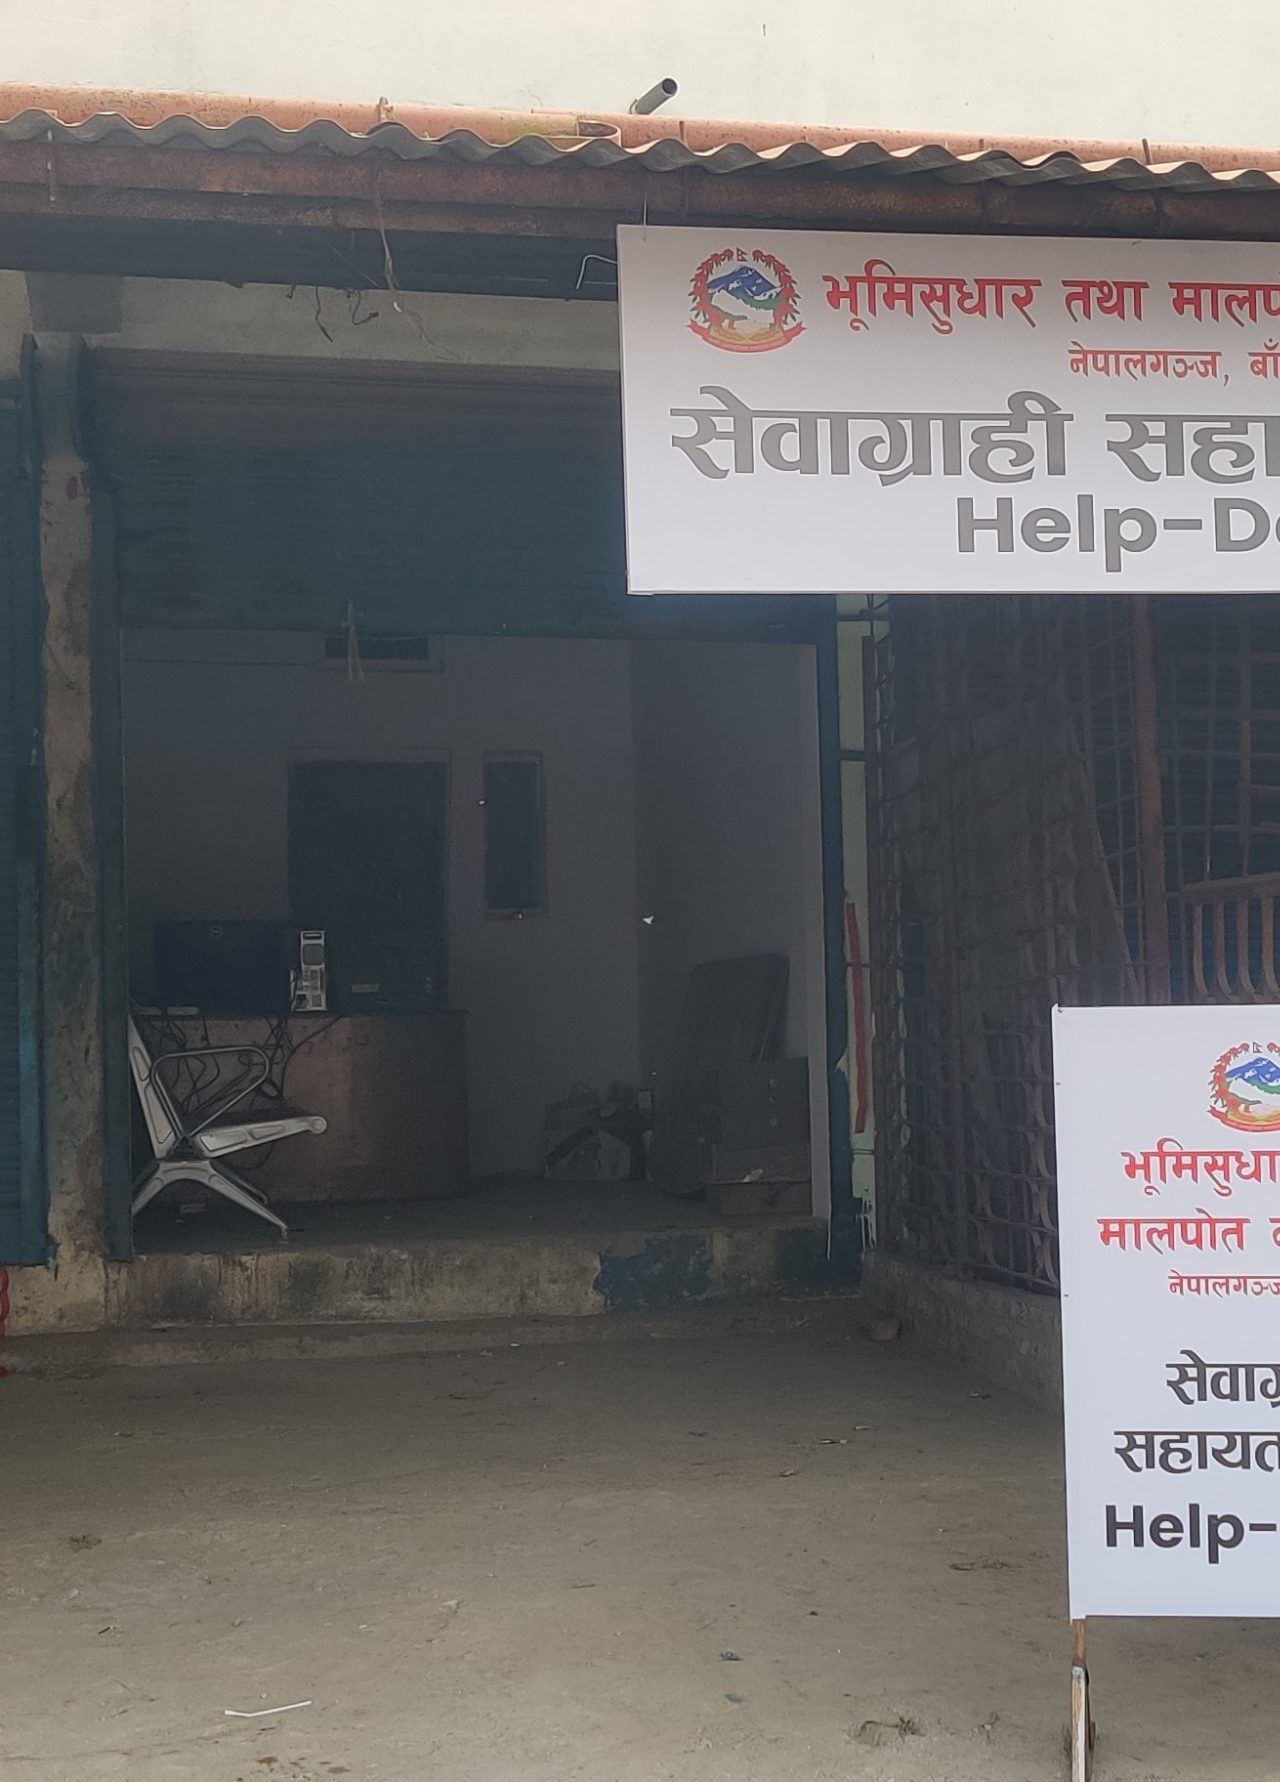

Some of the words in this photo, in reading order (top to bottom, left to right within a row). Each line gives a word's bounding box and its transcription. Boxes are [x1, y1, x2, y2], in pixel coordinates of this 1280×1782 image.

[820, 258, 1041, 333] भूमिसुधार
[1061, 278, 1148, 326] तथा
[670, 386, 1073, 486] सेवाग्राही
[1097, 1207, 1250, 1254] मालपोत
